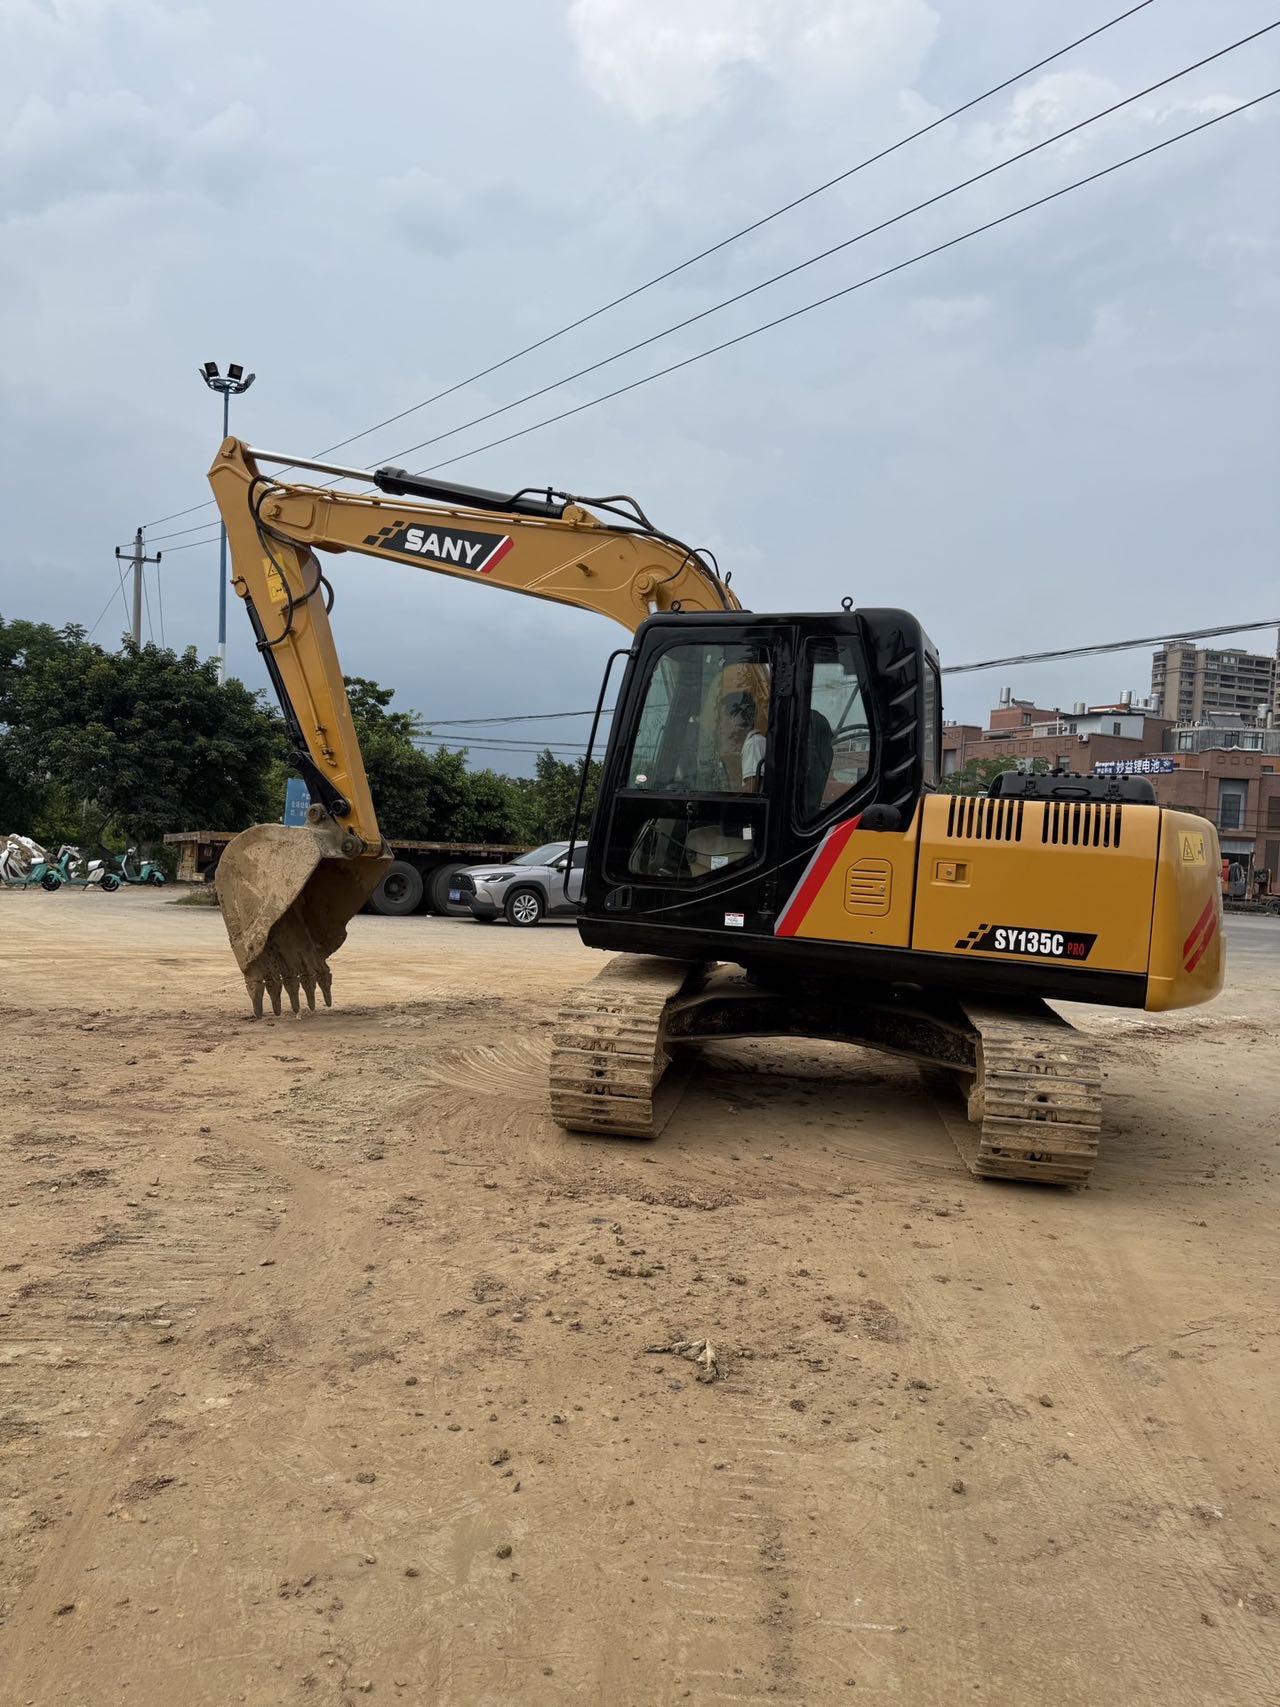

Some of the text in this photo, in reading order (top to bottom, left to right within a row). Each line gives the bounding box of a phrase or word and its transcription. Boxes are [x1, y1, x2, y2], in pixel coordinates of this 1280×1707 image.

[404, 528, 482, 564] SANY
[1115, 759, 1160, 774] 妙益锂电池
[994, 928, 1085, 956] SY135C PRO
